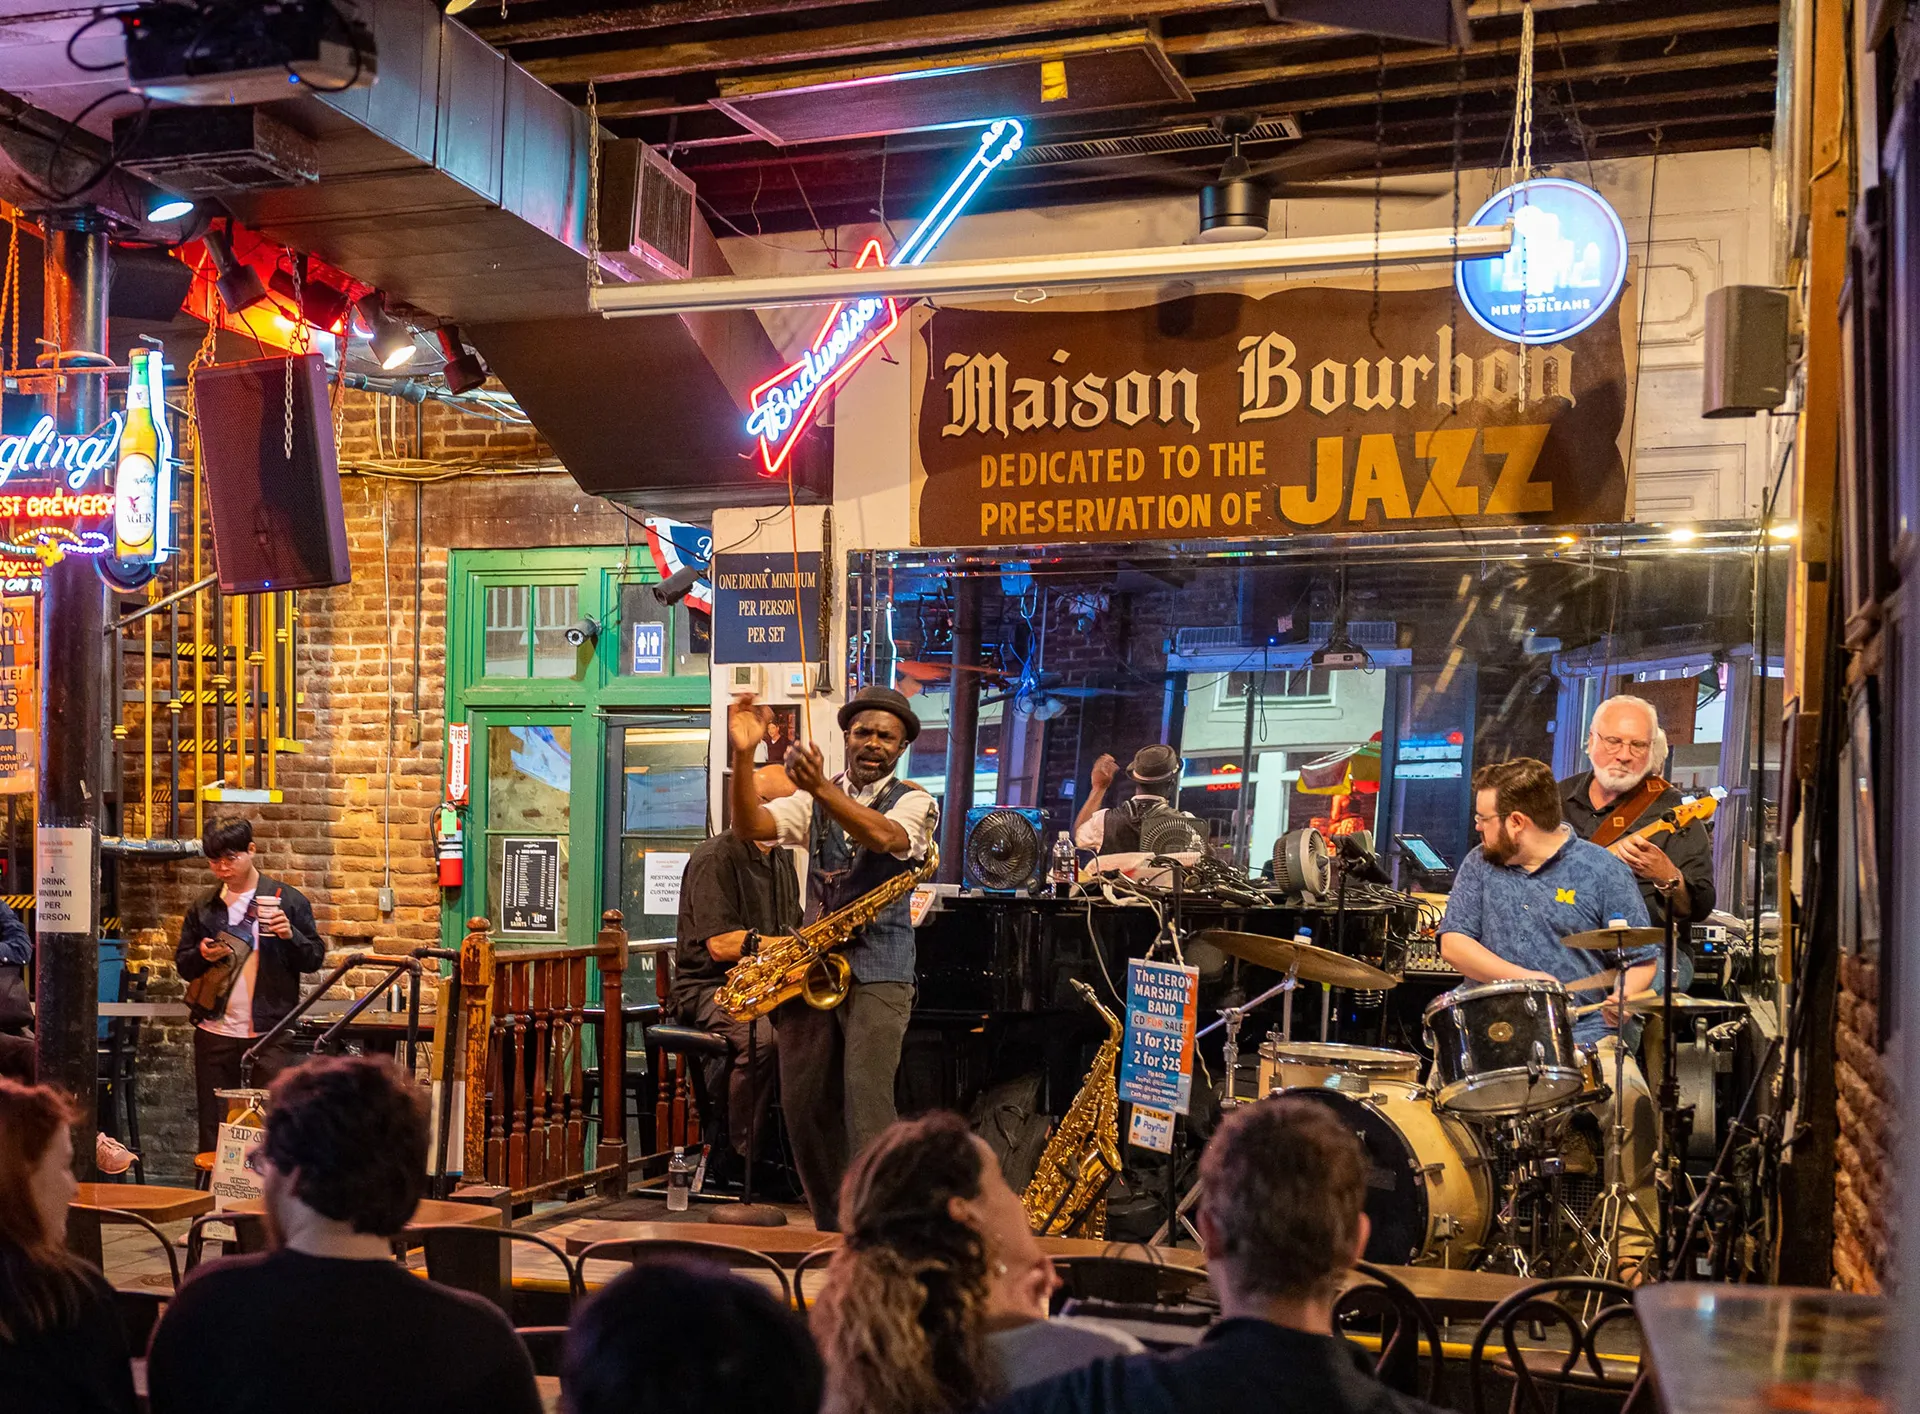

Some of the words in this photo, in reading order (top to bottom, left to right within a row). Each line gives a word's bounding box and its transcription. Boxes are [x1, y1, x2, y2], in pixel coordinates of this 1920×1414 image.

[1491, 304, 1521, 316] NEW
[1525, 298, 1591, 314] ORLEANS
[942, 349, 1200, 439] Maison
[1237, 323, 1577, 424] Bourbon
[981, 447, 1145, 488] DEDICATED
[1159, 444, 1201, 479] TO
[1209, 440, 1266, 477] THE
[1279, 423, 1554, 526] JAZZ
[26, 493, 116, 517] BREWERY
[981, 493, 1211, 536] PRESERVATION
[1220, 491, 1262, 525] OF
[718, 573, 738, 590] ONE
[738, 572, 769, 589] DRINK
[738, 600, 758, 616] PER
[759, 599, 795, 616] PERSON
[747, 626, 766, 643] PER
[768, 626, 785, 643] SET
[41, 877, 66, 886] DRINK
[38, 889, 72, 898] MINIMUM
[1554, 887, 1577, 905] M
[44, 901, 61, 909] PER
[38, 913, 71, 921] PERSON
[1135, 969, 1156, 983] The
[1158, 973, 1193, 989] LEROY
[1134, 983, 1191, 1005] MARSHALL
[1147, 1000, 1177, 1016] BAND
[1134, 1014, 1145, 1025] CD
[1146, 1017, 1163, 1028] FOR
[1164, 1020, 1187, 1033] SALE!
[1135, 1031, 1142, 1045] 1
[1144, 1032, 1161, 1048] for
[1163, 1035, 1183, 1053] $15
[1134, 1050, 1141, 1063] 2
[1143, 1051, 1160, 1067] for
[1162, 1054, 1182, 1072] $25
[1143, 1120, 1167, 1133] PayPal
